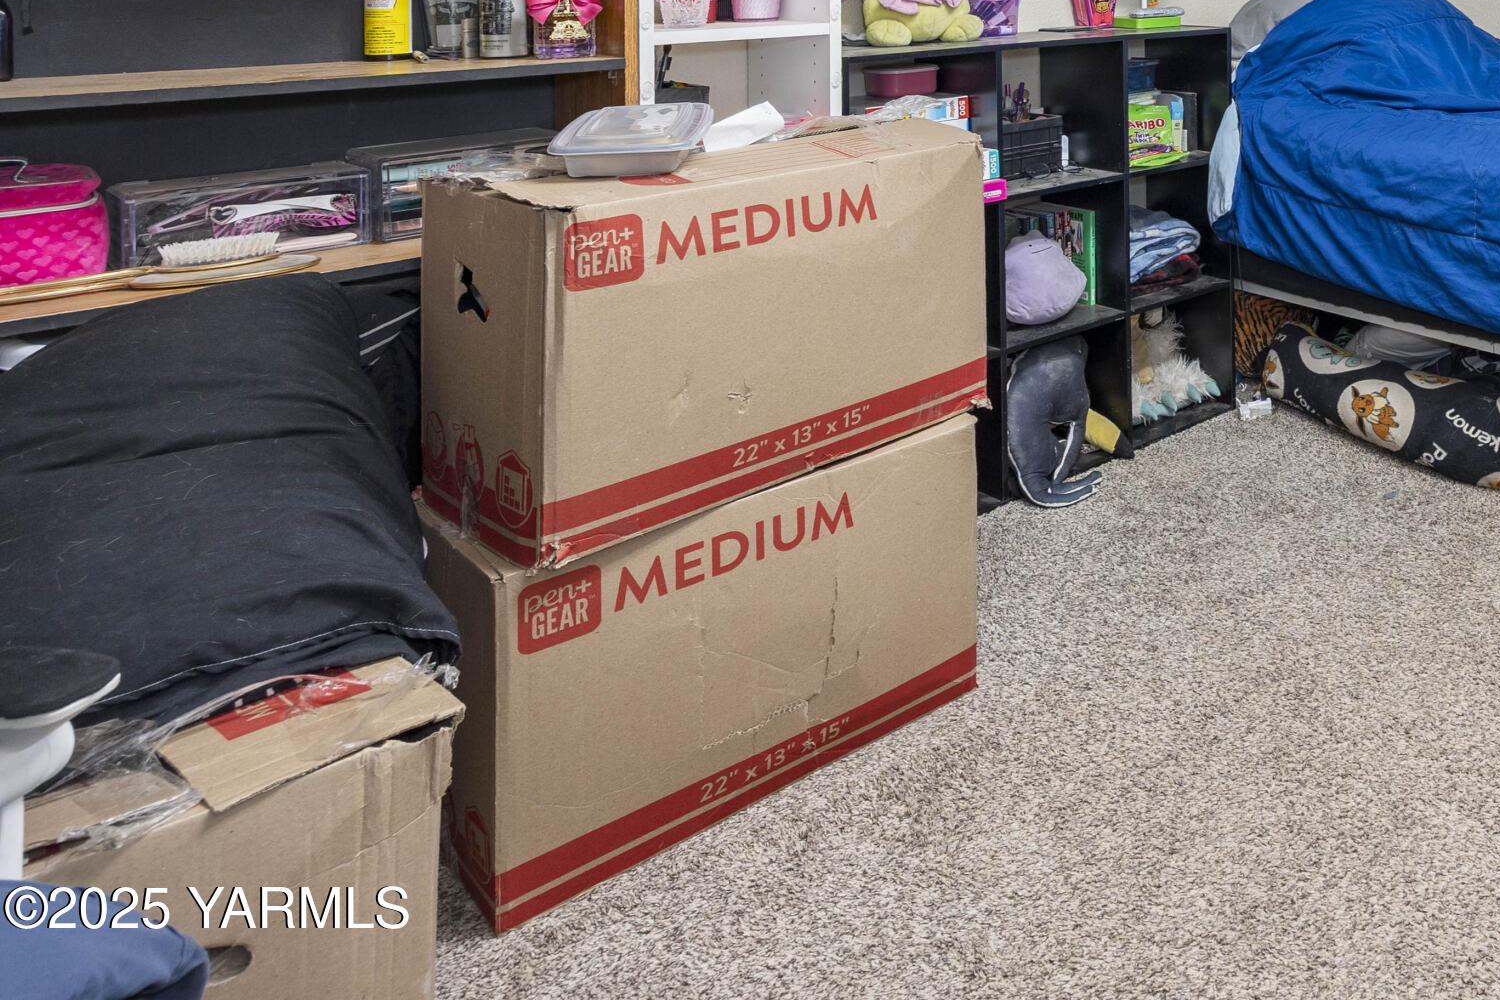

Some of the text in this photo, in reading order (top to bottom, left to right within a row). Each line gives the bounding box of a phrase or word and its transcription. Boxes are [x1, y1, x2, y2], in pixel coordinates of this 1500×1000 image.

[1127, 118, 1166, 130] ARIBO
[570, 228, 635, 260] pen+
[655, 184, 878, 265] MEDIUM
[577, 245, 633, 278] GEAR
[732, 405, 871, 468] 22" x 13" x 15"
[613, 492, 855, 613] MEDIUM
[523, 578, 594, 622] pen+
[531, 598, 590, 641] GEAR
[700, 770, 740, 802] 22"
[744, 766, 758, 783] x
[764, 744, 797, 772] 13"
[819, 716, 851, 742] 15"
